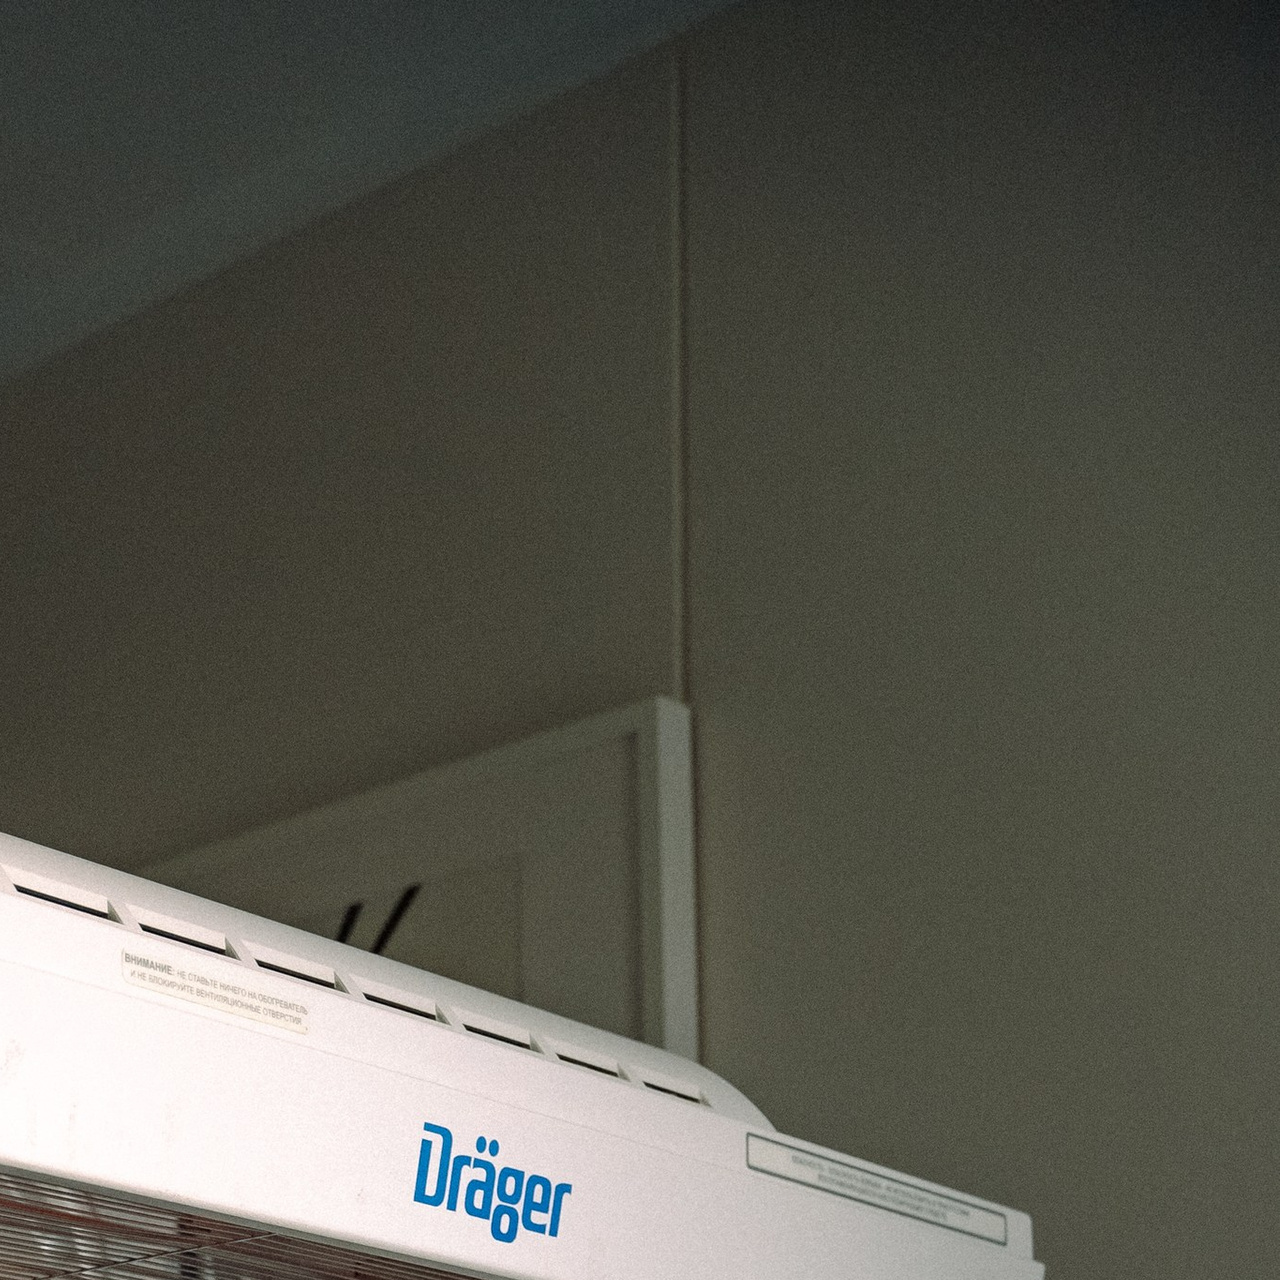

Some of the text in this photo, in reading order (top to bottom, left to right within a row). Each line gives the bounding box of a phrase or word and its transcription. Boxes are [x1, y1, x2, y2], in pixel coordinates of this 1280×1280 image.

[124, 953, 308, 1015] ВНИМАНИЕ: НЕ СТАВЬТЕ НИЧЕГО НА ОБОГРЕВАТЕЛЬ
[130, 969, 302, 1025] И НЕ БЛОКИРУЙТЕ ВЕНТИЛЯЦИОННЫЕ ОТВЕРСТИЯ
[413, 1121, 572, 1243] Dräger
